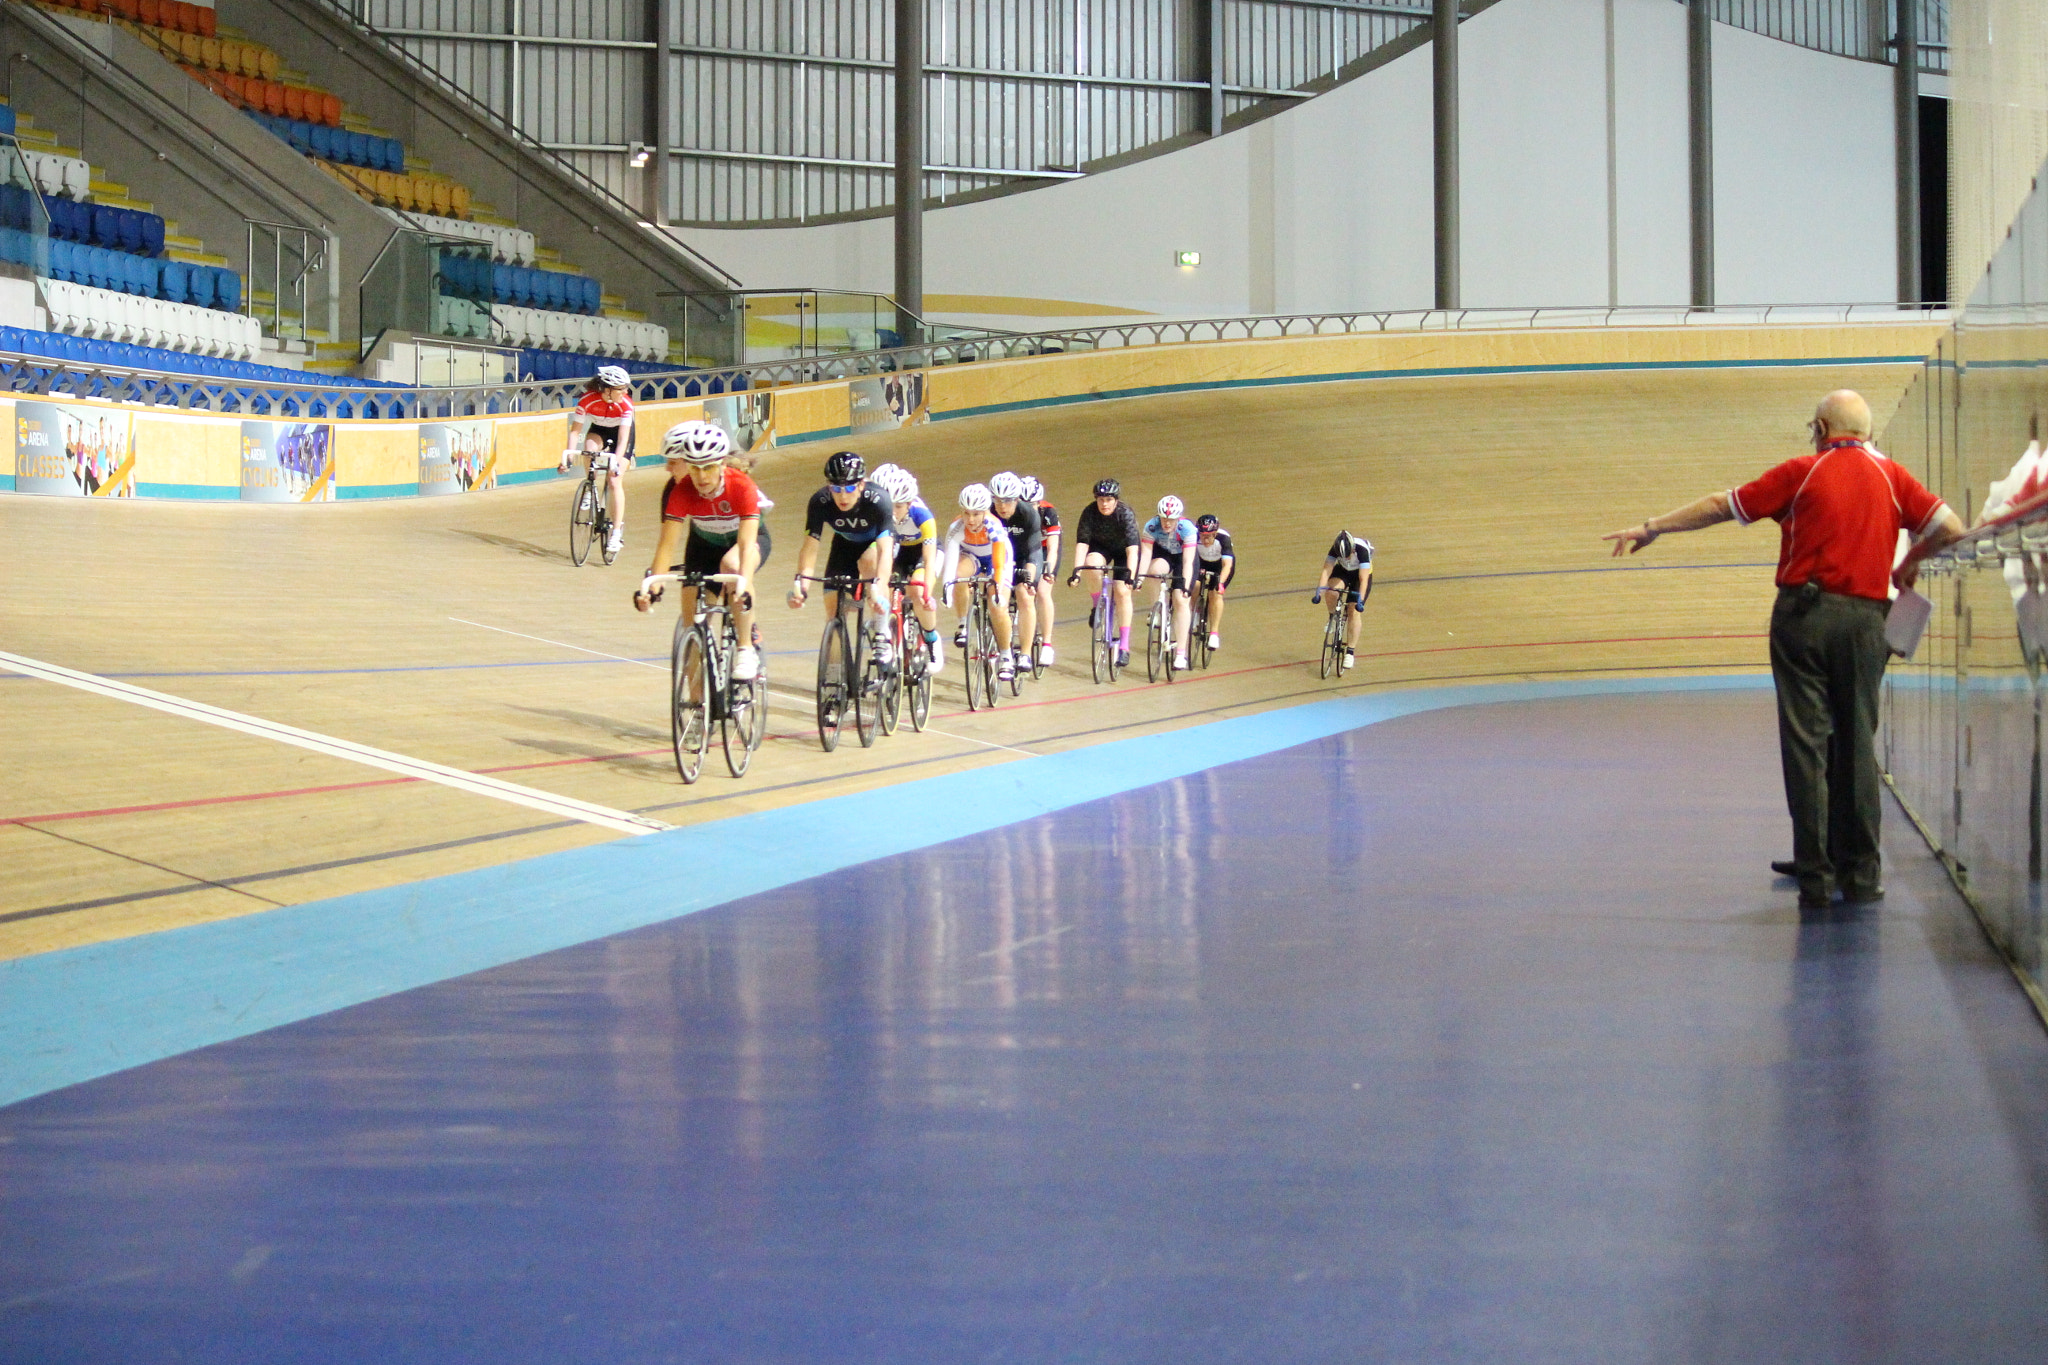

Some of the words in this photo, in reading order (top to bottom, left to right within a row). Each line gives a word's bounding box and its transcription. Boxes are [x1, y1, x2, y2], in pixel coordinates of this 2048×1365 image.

[28, 431, 49, 446] ARENA
[18, 454, 65, 479] CLASSES
[243, 467, 278, 487] CYCLING
[835, 517, 868, 528] OVB
